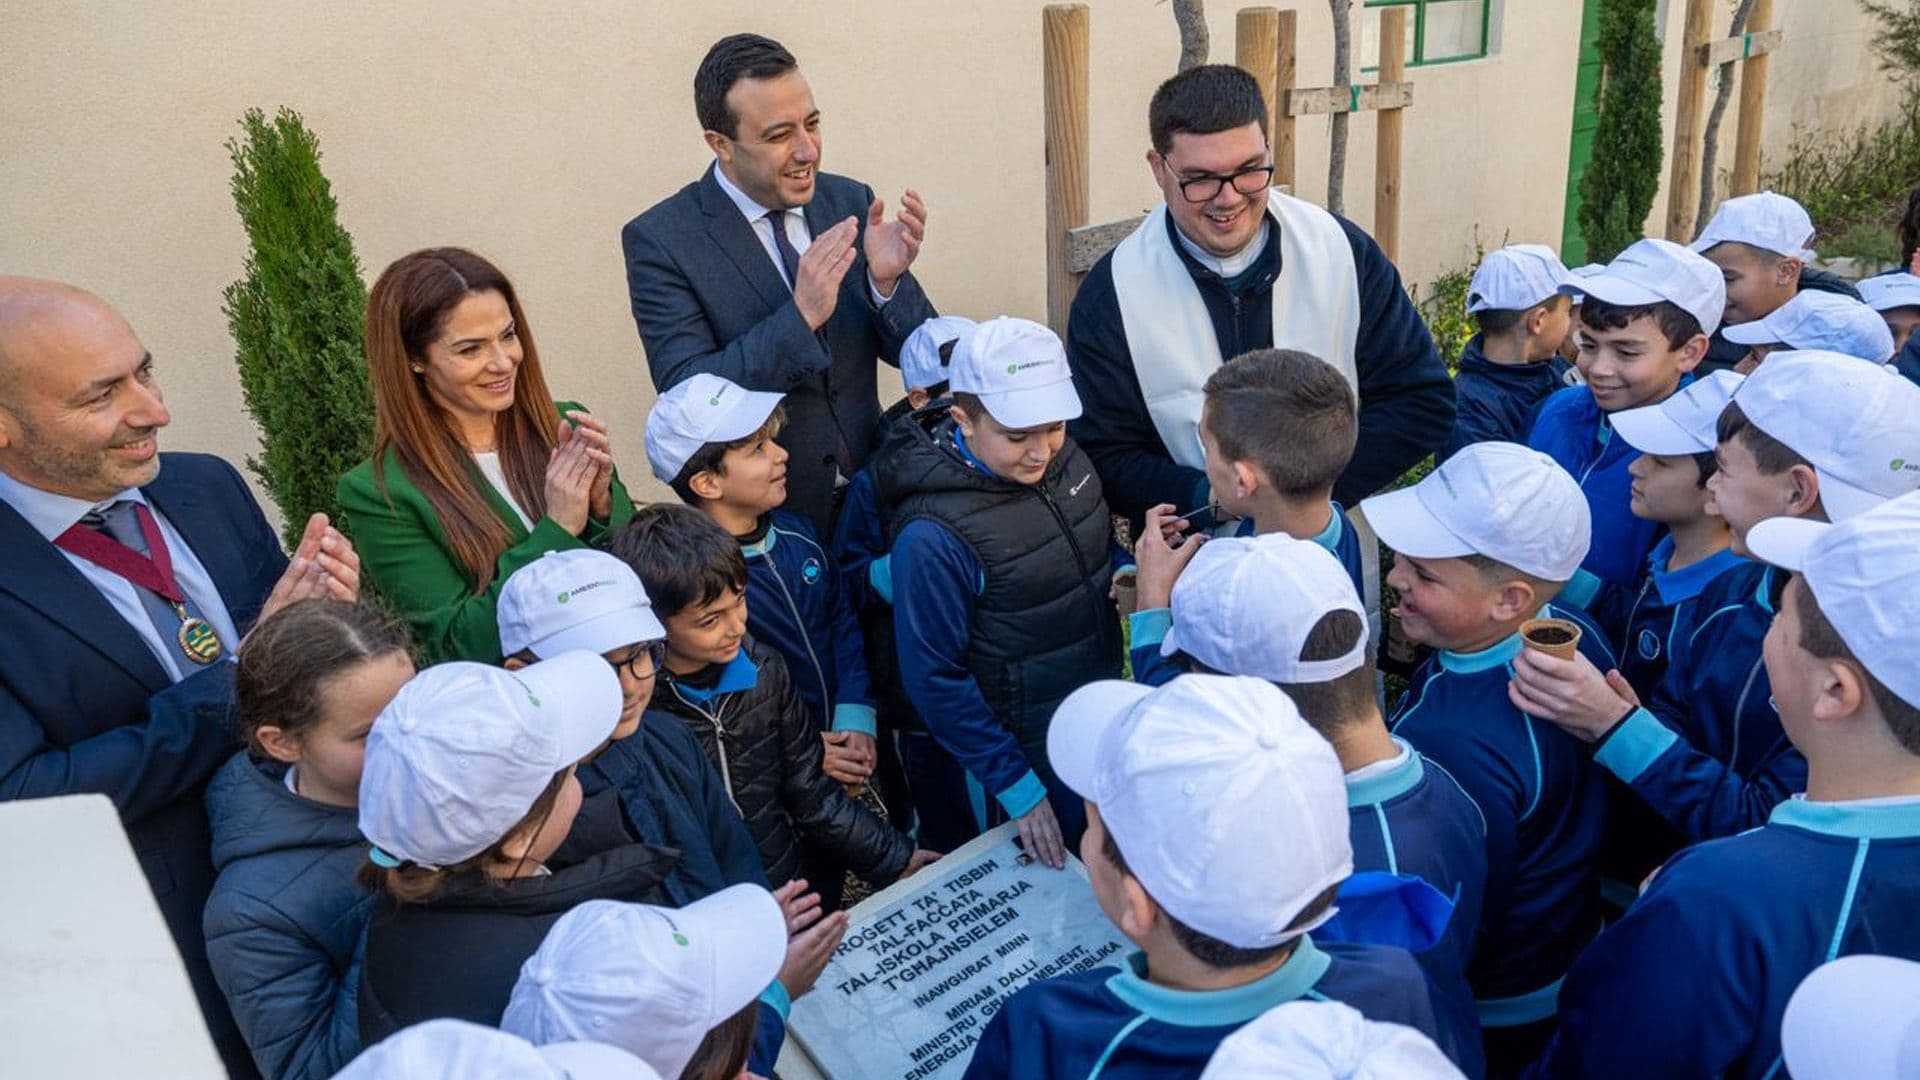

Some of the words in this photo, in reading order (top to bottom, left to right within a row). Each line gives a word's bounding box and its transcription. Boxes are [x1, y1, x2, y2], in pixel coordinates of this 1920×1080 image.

[829, 909, 907, 962] ROĠETT
[911, 891, 939, 912] TA'
[837, 931, 946, 996] TAL-ISKOLA
[946, 879, 1034, 933] PRIMARJA
[913, 955, 993, 1009] INAWGURAT
[995, 932, 1031, 959] MINN
[945, 985, 997, 1021] MIRIAM
[998, 959, 1038, 988] DALLI
[909, 1015, 977, 1062] MINISTRU
